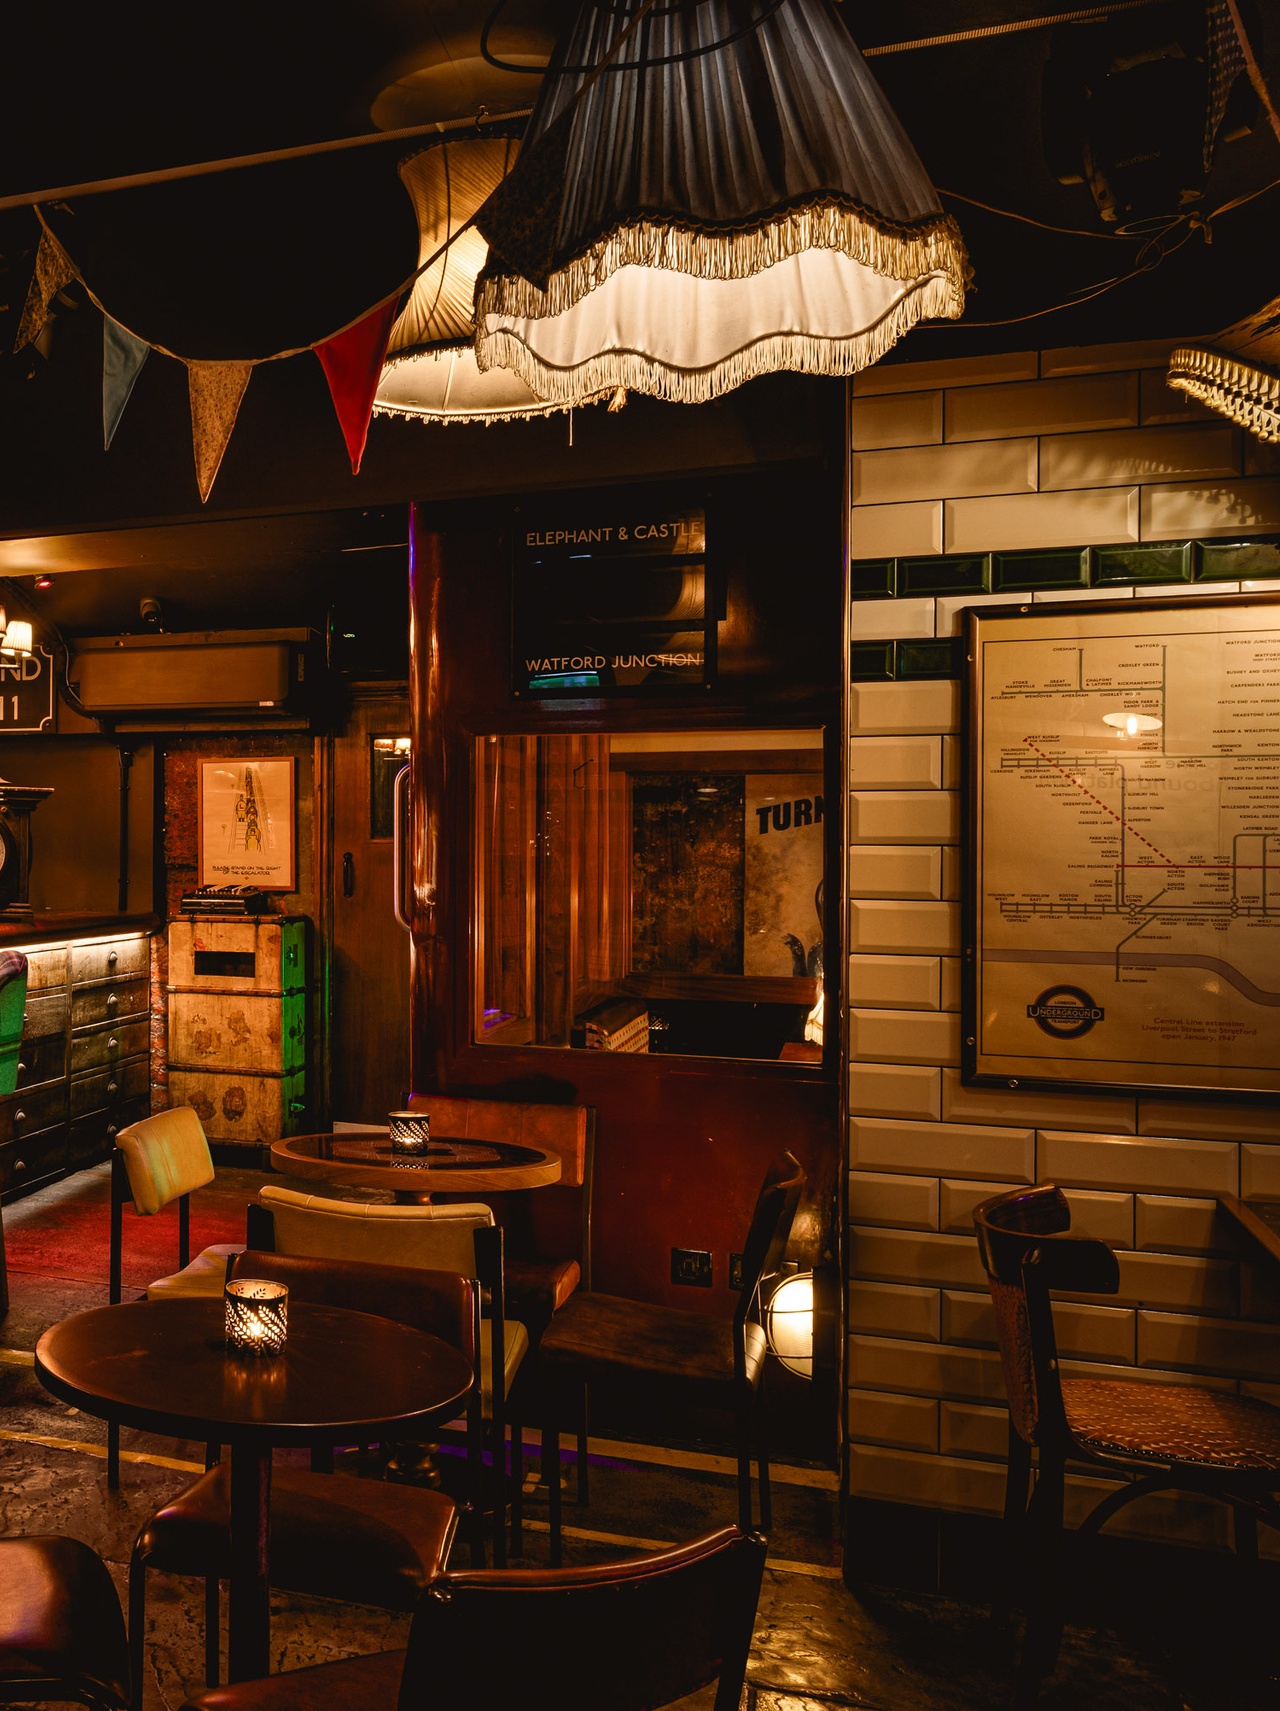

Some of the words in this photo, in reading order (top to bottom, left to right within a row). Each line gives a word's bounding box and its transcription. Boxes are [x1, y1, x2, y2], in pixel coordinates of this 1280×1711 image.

[526, 527, 613, 546] ELEPHANT
[618, 527, 629, 541] &
[634, 521, 702, 538] CASTLE
[525, 656, 606, 672] WATFORD
[611, 653, 701, 668] JUNCTION
[12, 695, 19, 721] 1
[1029, 1006, 1101, 1019] UNDERGROUND
[1153, 1017, 1184, 1025] Central
[1142, 1025, 1178, 1033] Liverpool
[1219, 1027, 1257, 1035] Stratford
[1184, 1034, 1216, 1042] January,
